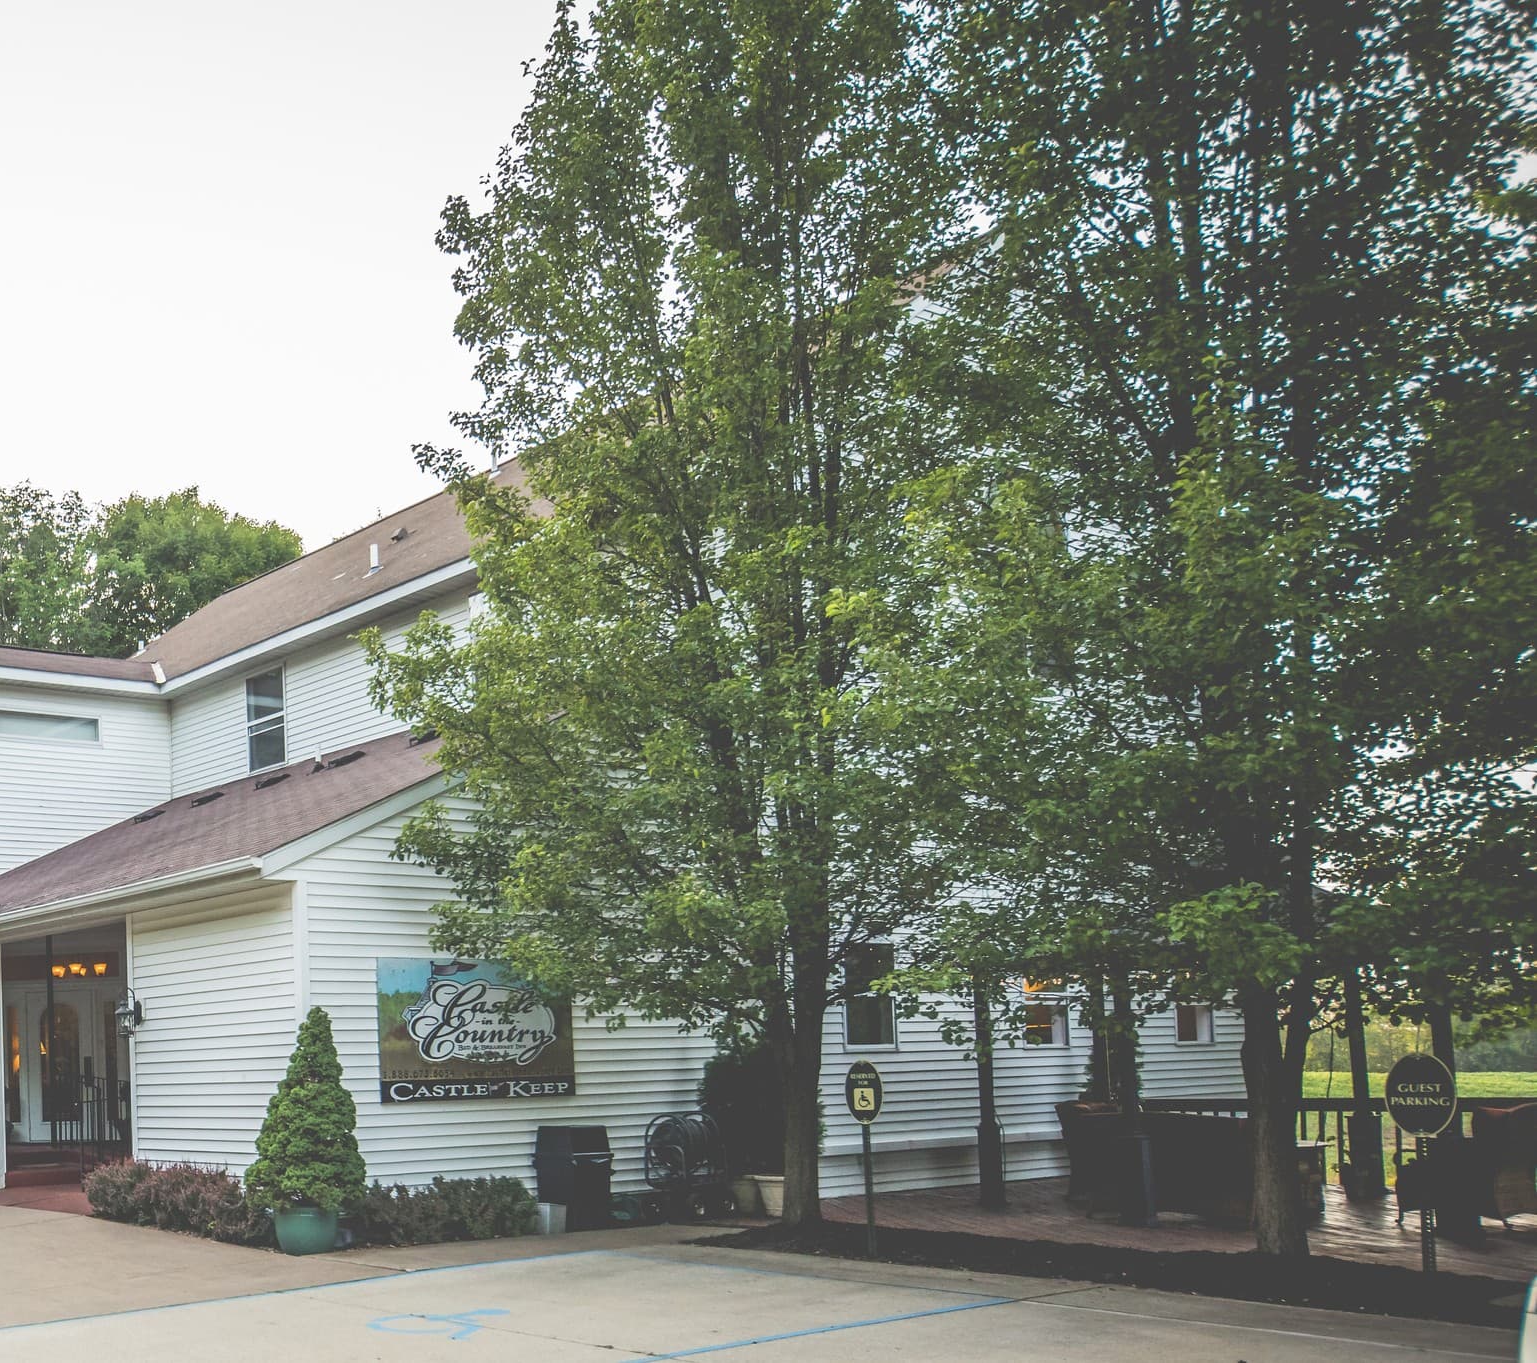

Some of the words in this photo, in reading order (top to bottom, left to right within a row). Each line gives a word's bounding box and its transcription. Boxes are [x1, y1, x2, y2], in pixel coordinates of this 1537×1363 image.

[431, 983, 536, 1029] Casle
[411, 1015, 554, 1064] Country
[389, 1081, 489, 1102] CASTLE
[505, 1080, 569, 1098] KEEP
[1397, 1083, 1441, 1093] GUEST
[1390, 1096, 1451, 1106] PARKING
